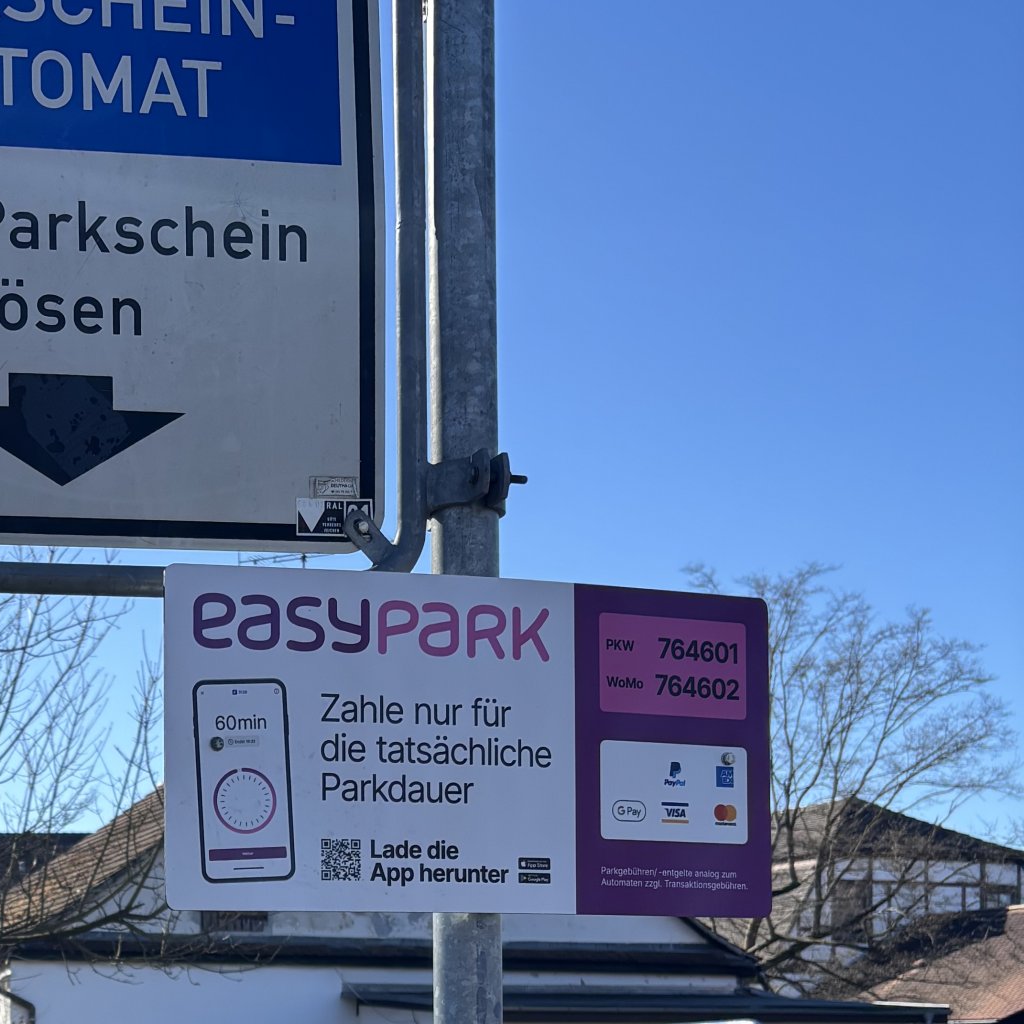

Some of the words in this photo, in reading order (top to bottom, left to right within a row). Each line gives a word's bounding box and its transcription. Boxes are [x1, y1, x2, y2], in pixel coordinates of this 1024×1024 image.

[327, 501, 343, 510] RAL
[606, 639, 634, 651] PKW
[658, 637, 738, 664] 764601
[606, 676, 643, 689] WoMo
[655, 674, 740, 701] 764602
[320, 694, 404, 725] Zahle
[414, 701, 462, 726] nur
[471, 697, 512, 728] für
[320, 733, 366, 762] die
[376, 735, 552, 768] tatsächliche
[320, 773, 474, 804] Parkdauer
[664, 779, 686, 787] PayPal
[627, 807, 642, 818] Pay
[665, 808, 686, 818] VISA
[370, 840, 422, 859] Lade
[427, 840, 459, 859] die
[370, 863, 414, 886] App
[419, 863, 509, 883] herunter
[601, 867, 657, 877] Parkgebühren/
[659, 869, 692, 878] -entgelte
[695, 869, 719, 879] analog
[601, 878, 642, 887] Automaten
[644, 879, 662, 889] zzgl.
[664, 880, 748, 891] Transaktionsgebühren.
